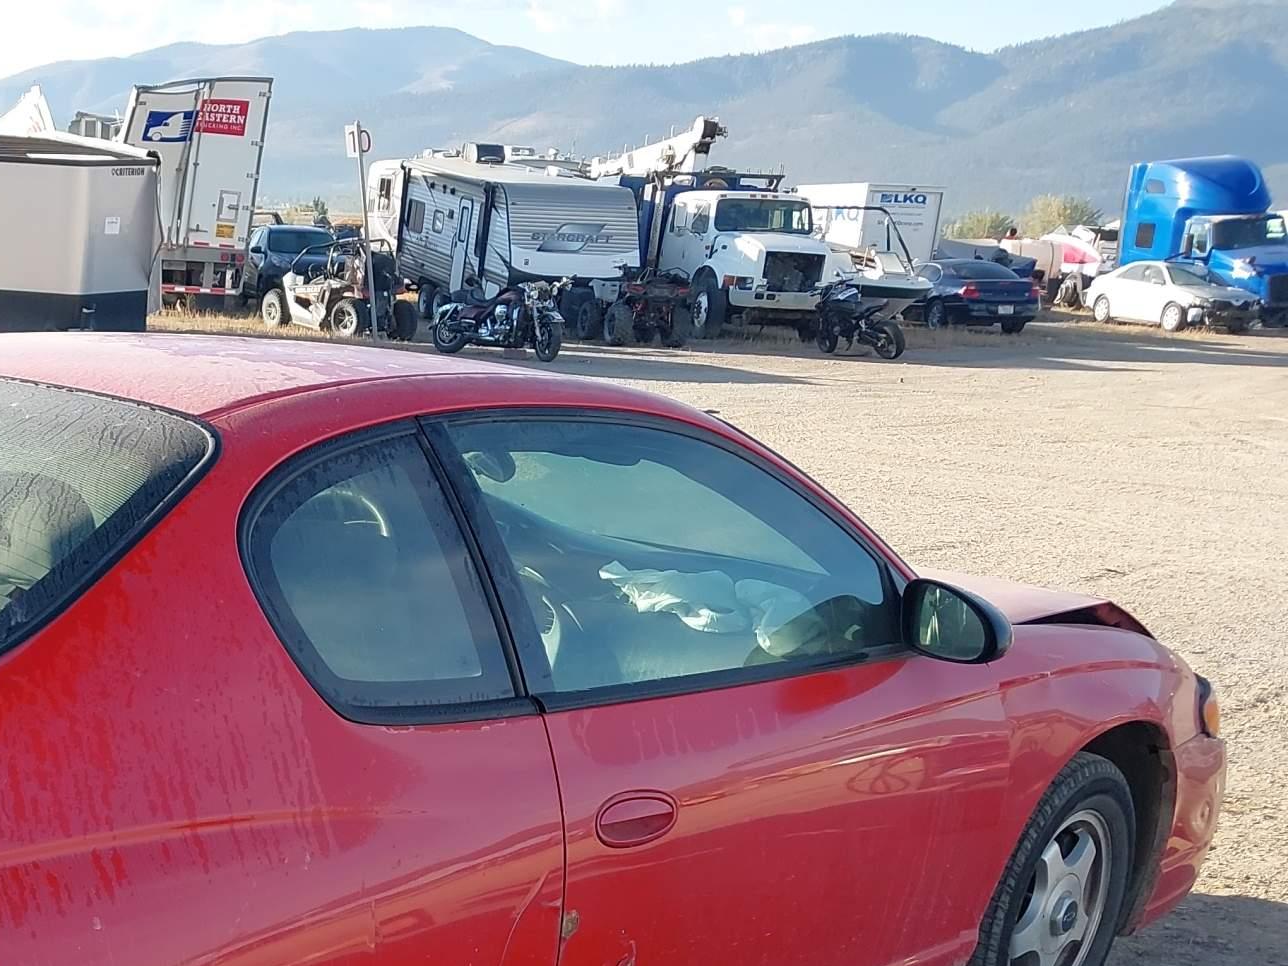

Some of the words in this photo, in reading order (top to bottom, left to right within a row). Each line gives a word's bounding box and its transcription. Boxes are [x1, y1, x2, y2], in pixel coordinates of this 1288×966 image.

[203, 103, 241, 114] NORTH
[348, 129, 372, 153] 10
[893, 193, 927, 205] LKQ
[530, 232, 614, 245] STARCRAFT
